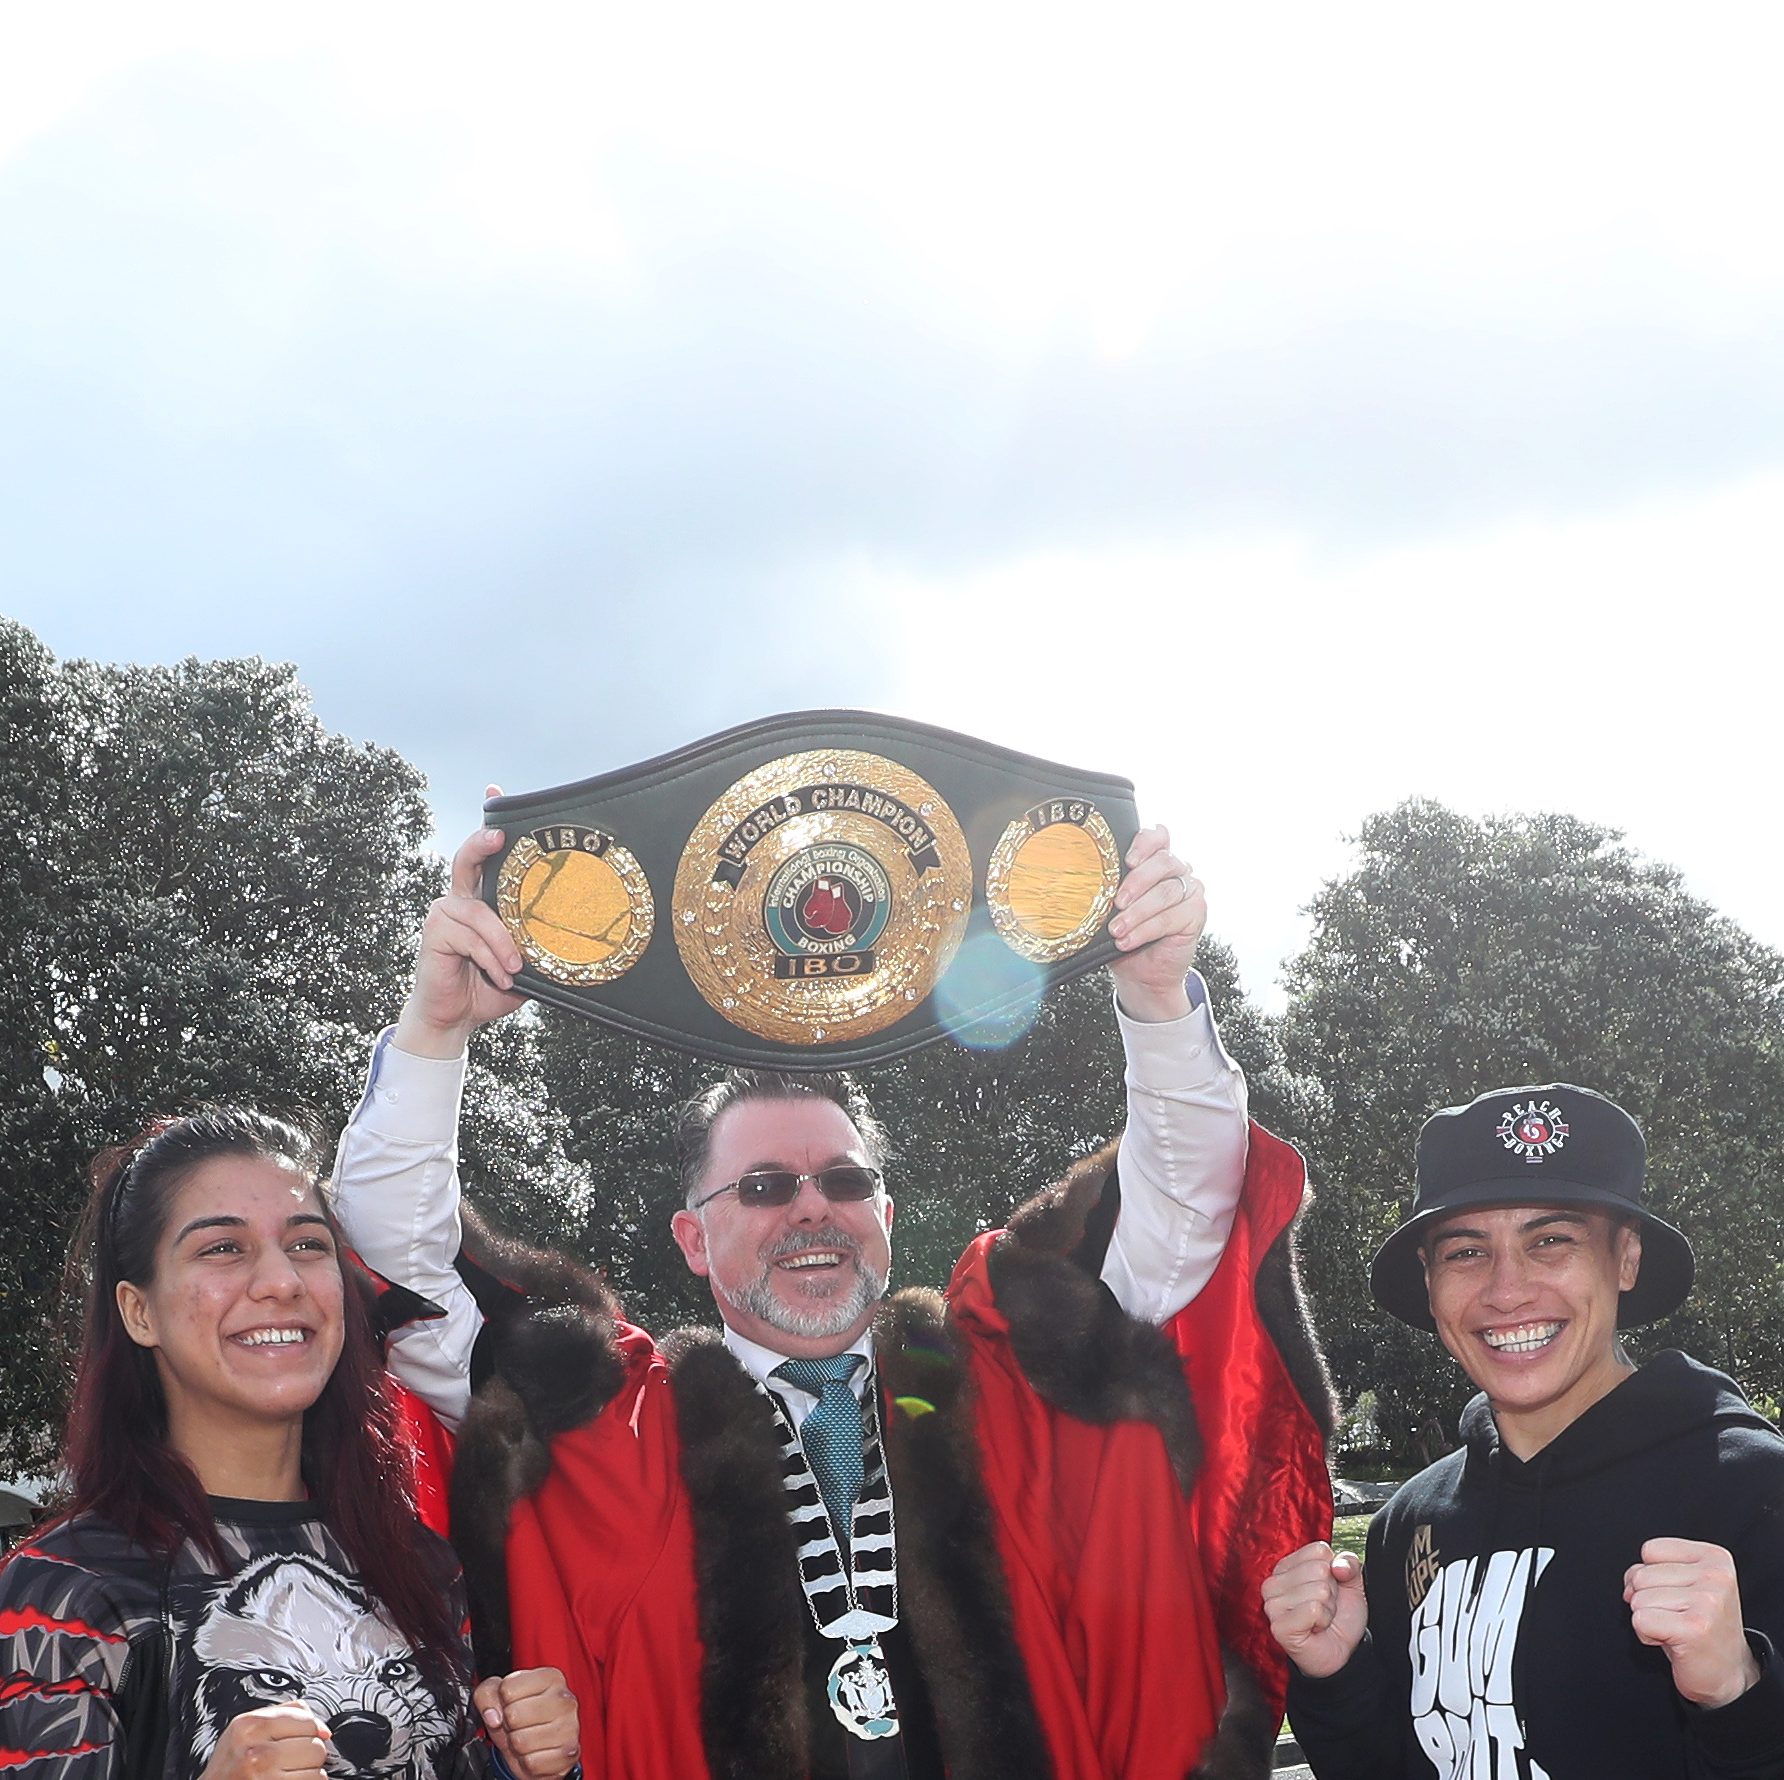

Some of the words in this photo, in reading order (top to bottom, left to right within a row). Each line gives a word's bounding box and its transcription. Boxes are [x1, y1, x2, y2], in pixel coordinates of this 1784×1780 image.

[724, 795, 803, 859] WORLD
[811, 786, 931, 849] CHAMPION
[1037, 801, 1085, 826] IBO
[544, 828, 601, 852] IBO
[782, 862, 875, 909] CHAMPIONSHIP
[797, 934, 857, 954] BOXING
[789, 955, 862, 976] IBO
[1504, 1138, 1564, 1157] BOXING
[1409, 1547, 1555, 1717] GUM
